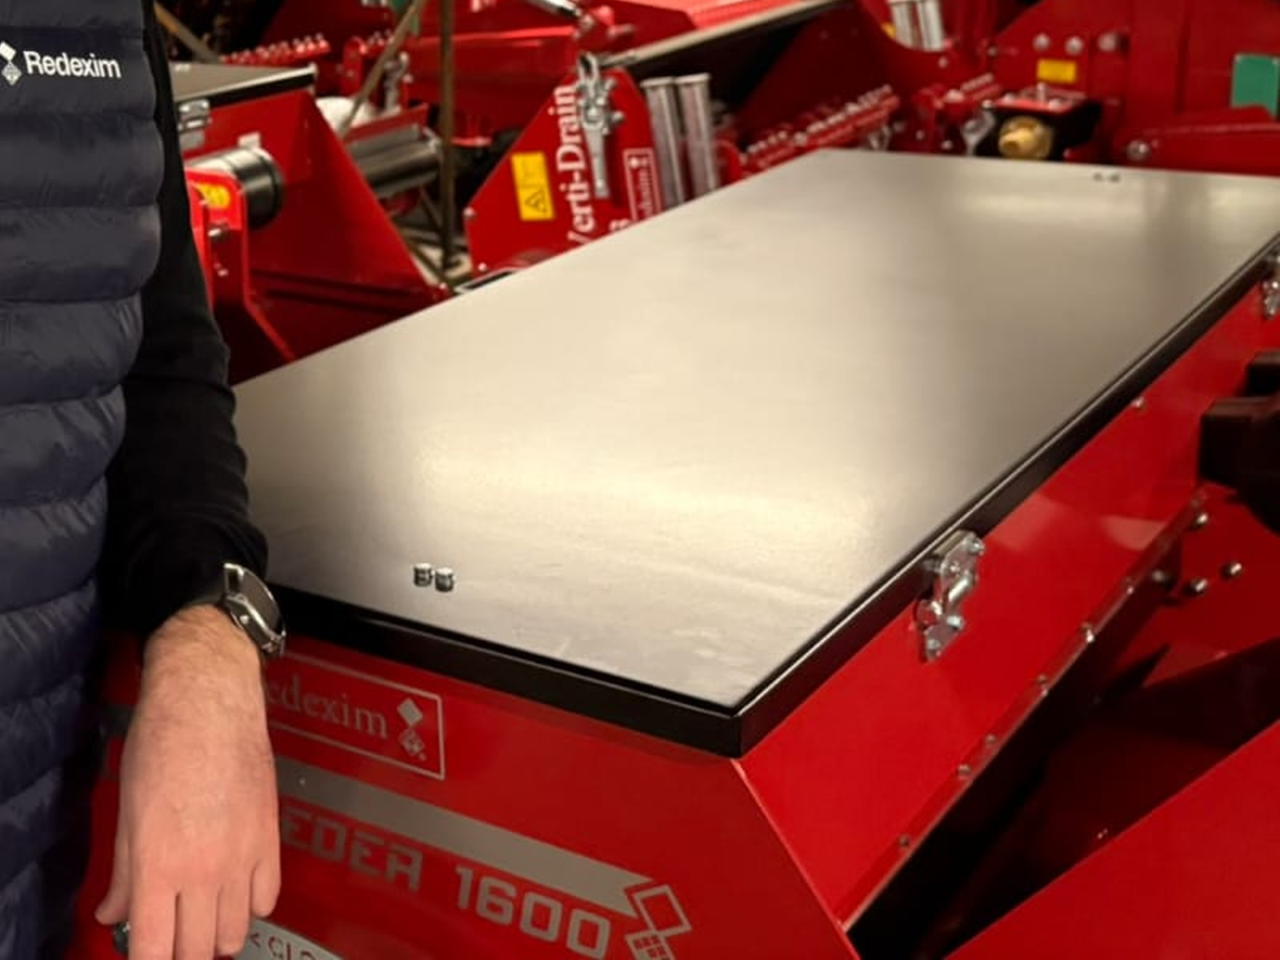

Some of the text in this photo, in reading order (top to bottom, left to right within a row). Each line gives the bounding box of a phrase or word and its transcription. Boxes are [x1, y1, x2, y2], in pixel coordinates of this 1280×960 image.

[23, 50, 121, 78] Redexim
[267, 674, 388, 739] edexim
[280, 806, 611, 959] EDER 1600
